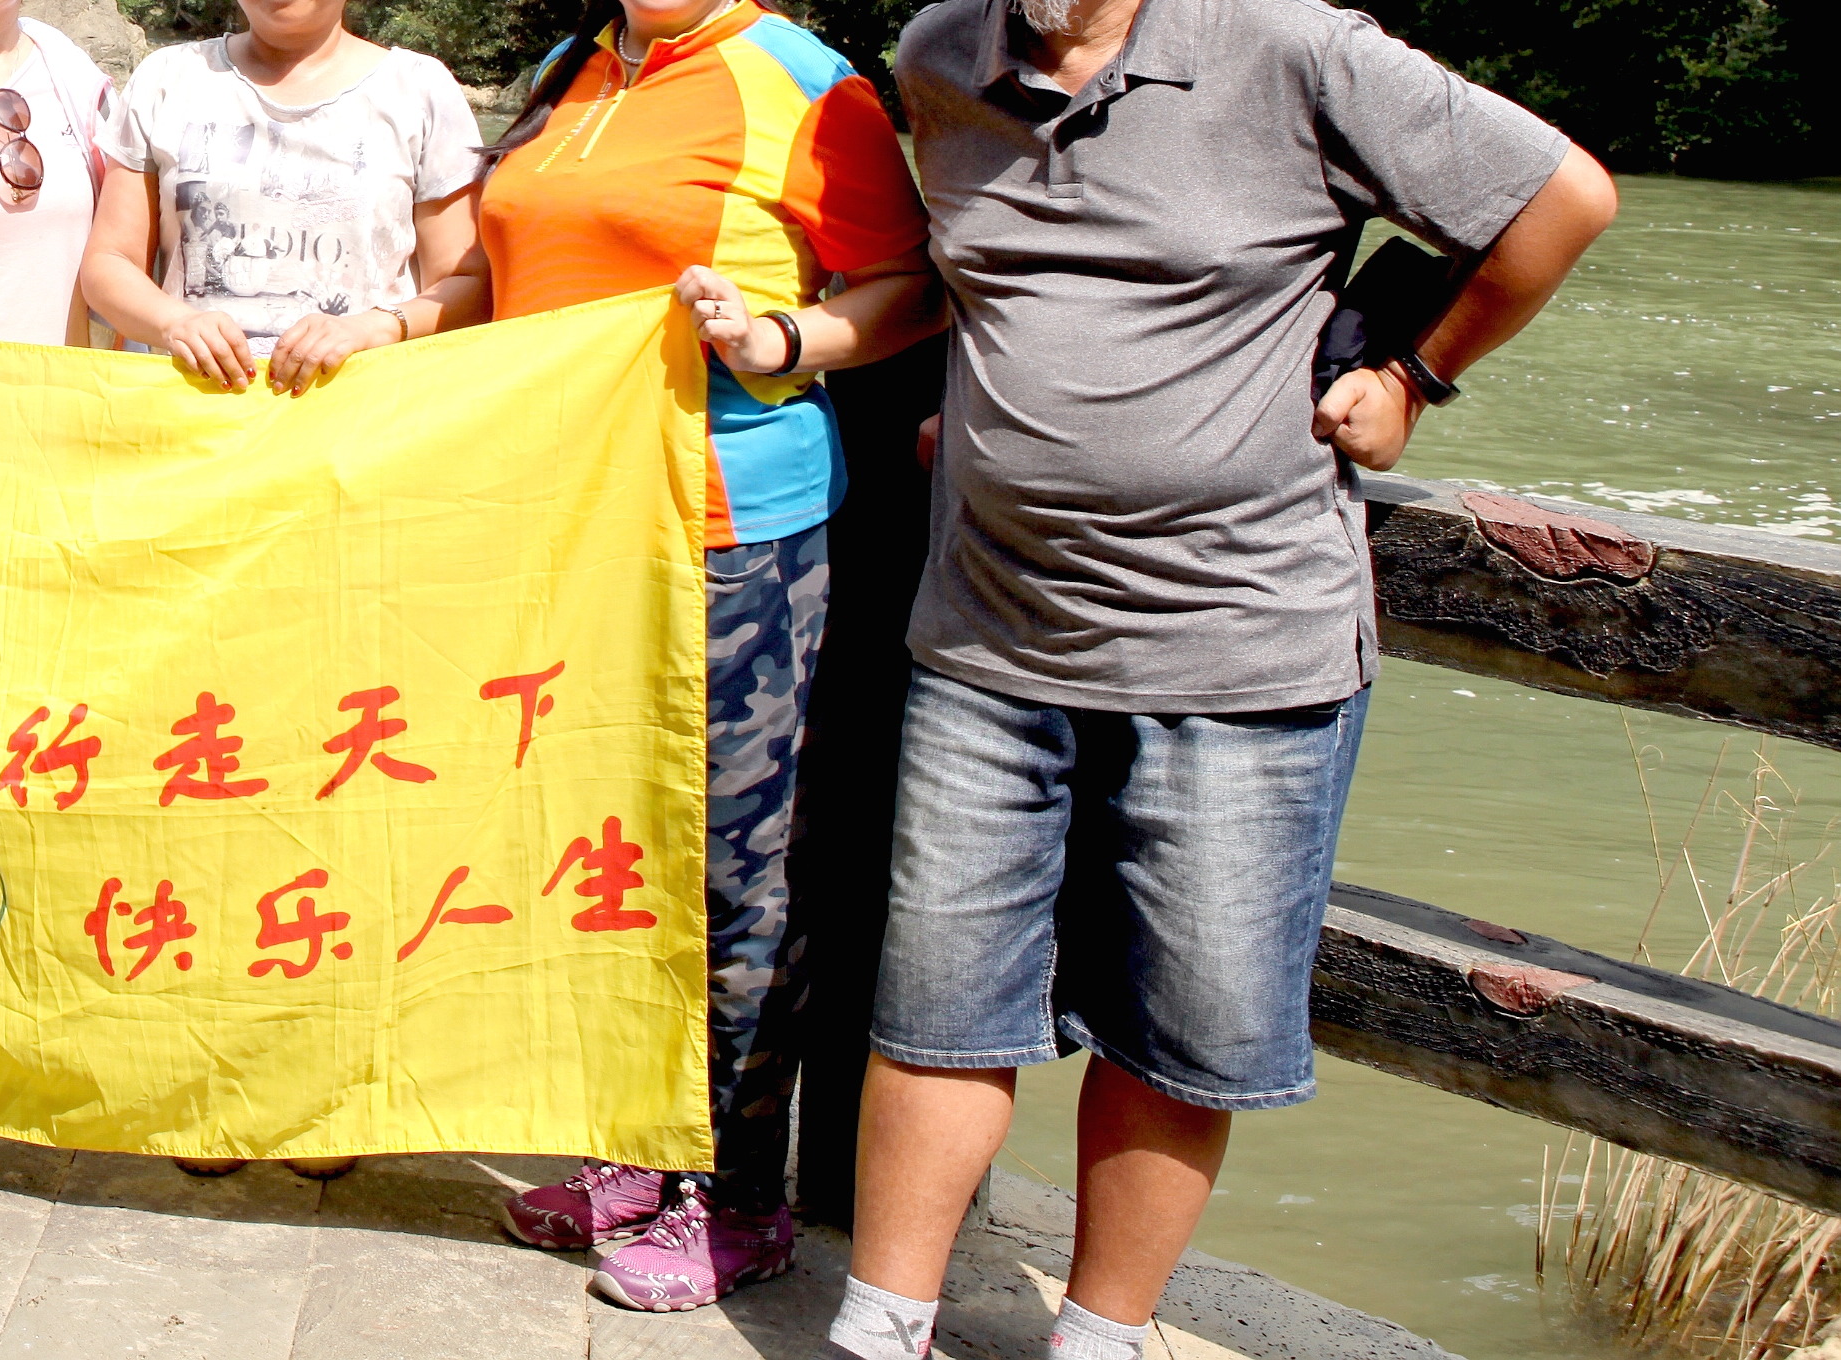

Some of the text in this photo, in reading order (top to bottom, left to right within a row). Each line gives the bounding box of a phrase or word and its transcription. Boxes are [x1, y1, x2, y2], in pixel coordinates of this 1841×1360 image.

[535, 135, 573, 173] FASHION
[84, 816, 658, 982] 快乐人生
